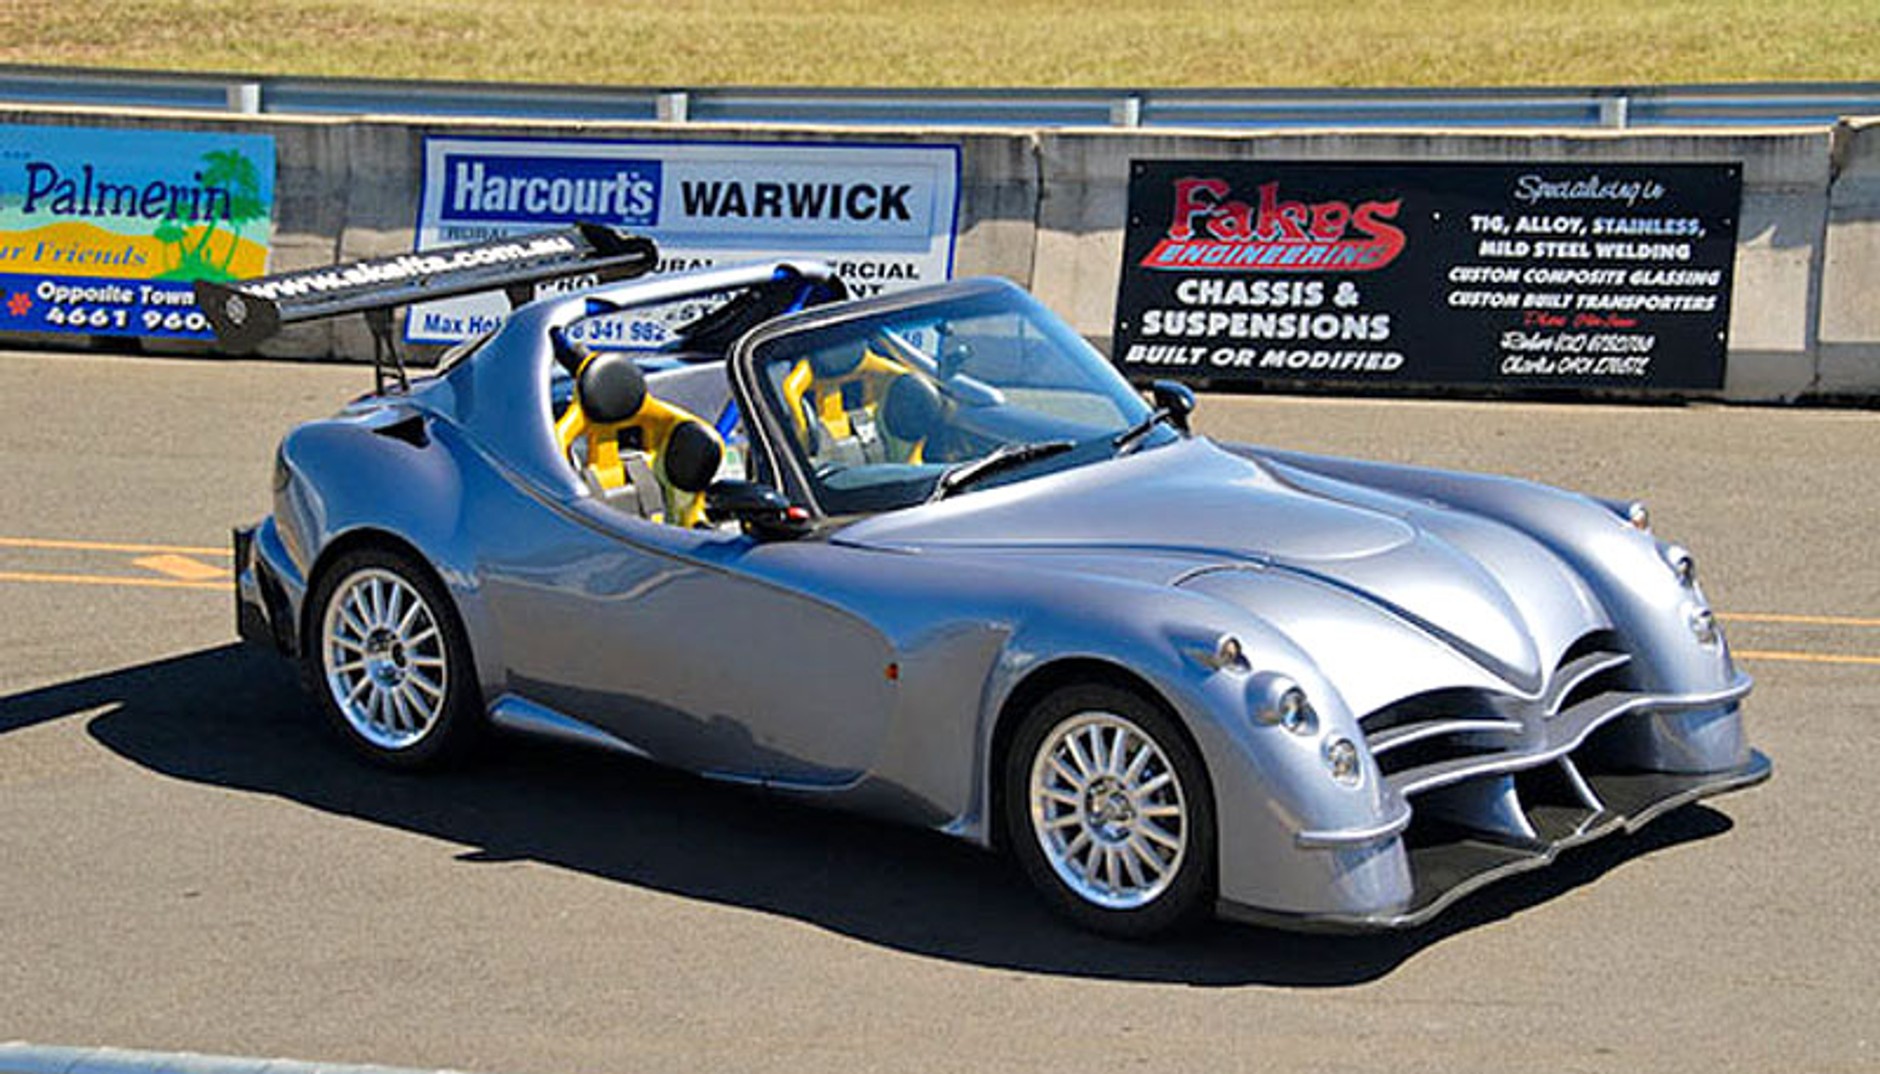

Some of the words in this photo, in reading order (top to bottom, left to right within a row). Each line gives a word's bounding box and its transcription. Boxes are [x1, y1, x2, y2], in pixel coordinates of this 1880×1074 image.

[22, 162, 230, 220] Palmerin
[681, 181, 913, 220] WARWICK
[1168, 178, 1405, 243] Fakes
[1470, 215, 1511, 235] TIG,
[1514, 216, 1588, 236] ALLOY,
[1591, 217, 1707, 238] STAINLESS,
[34, 242, 148, 264] Friends
[1157, 243, 1388, 265] ENGINEERING
[1478, 240, 1531, 258] MILD
[1533, 242, 1592, 259] STEEL
[1595, 243, 1692, 260] WELDING
[1448, 267, 1521, 283] CUSTOM
[1523, 268, 1625, 286] COMPOSITE
[1628, 270, 1722, 287] GLASSING
[36, 281, 134, 304] Opposite
[139, 284, 196, 306] Town
[1176, 280, 1324, 306] CHASSIS
[1333, 281, 1360, 307] &
[1448, 291, 1520, 307] CUSTOM
[1522, 292, 1574, 309] BUILT
[1575, 293, 1717, 312] TRANSPORTERS
[46, 306, 128, 328] 4661
[142, 309, 212, 330] 960
[424, 314, 463, 334] Max
[1141, 310, 1391, 340] SUSPENSIONS
[1125, 345, 1207, 365] BUILT
[1210, 348, 1256, 367] OR
[1260, 350, 1404, 371] MODIFIED
